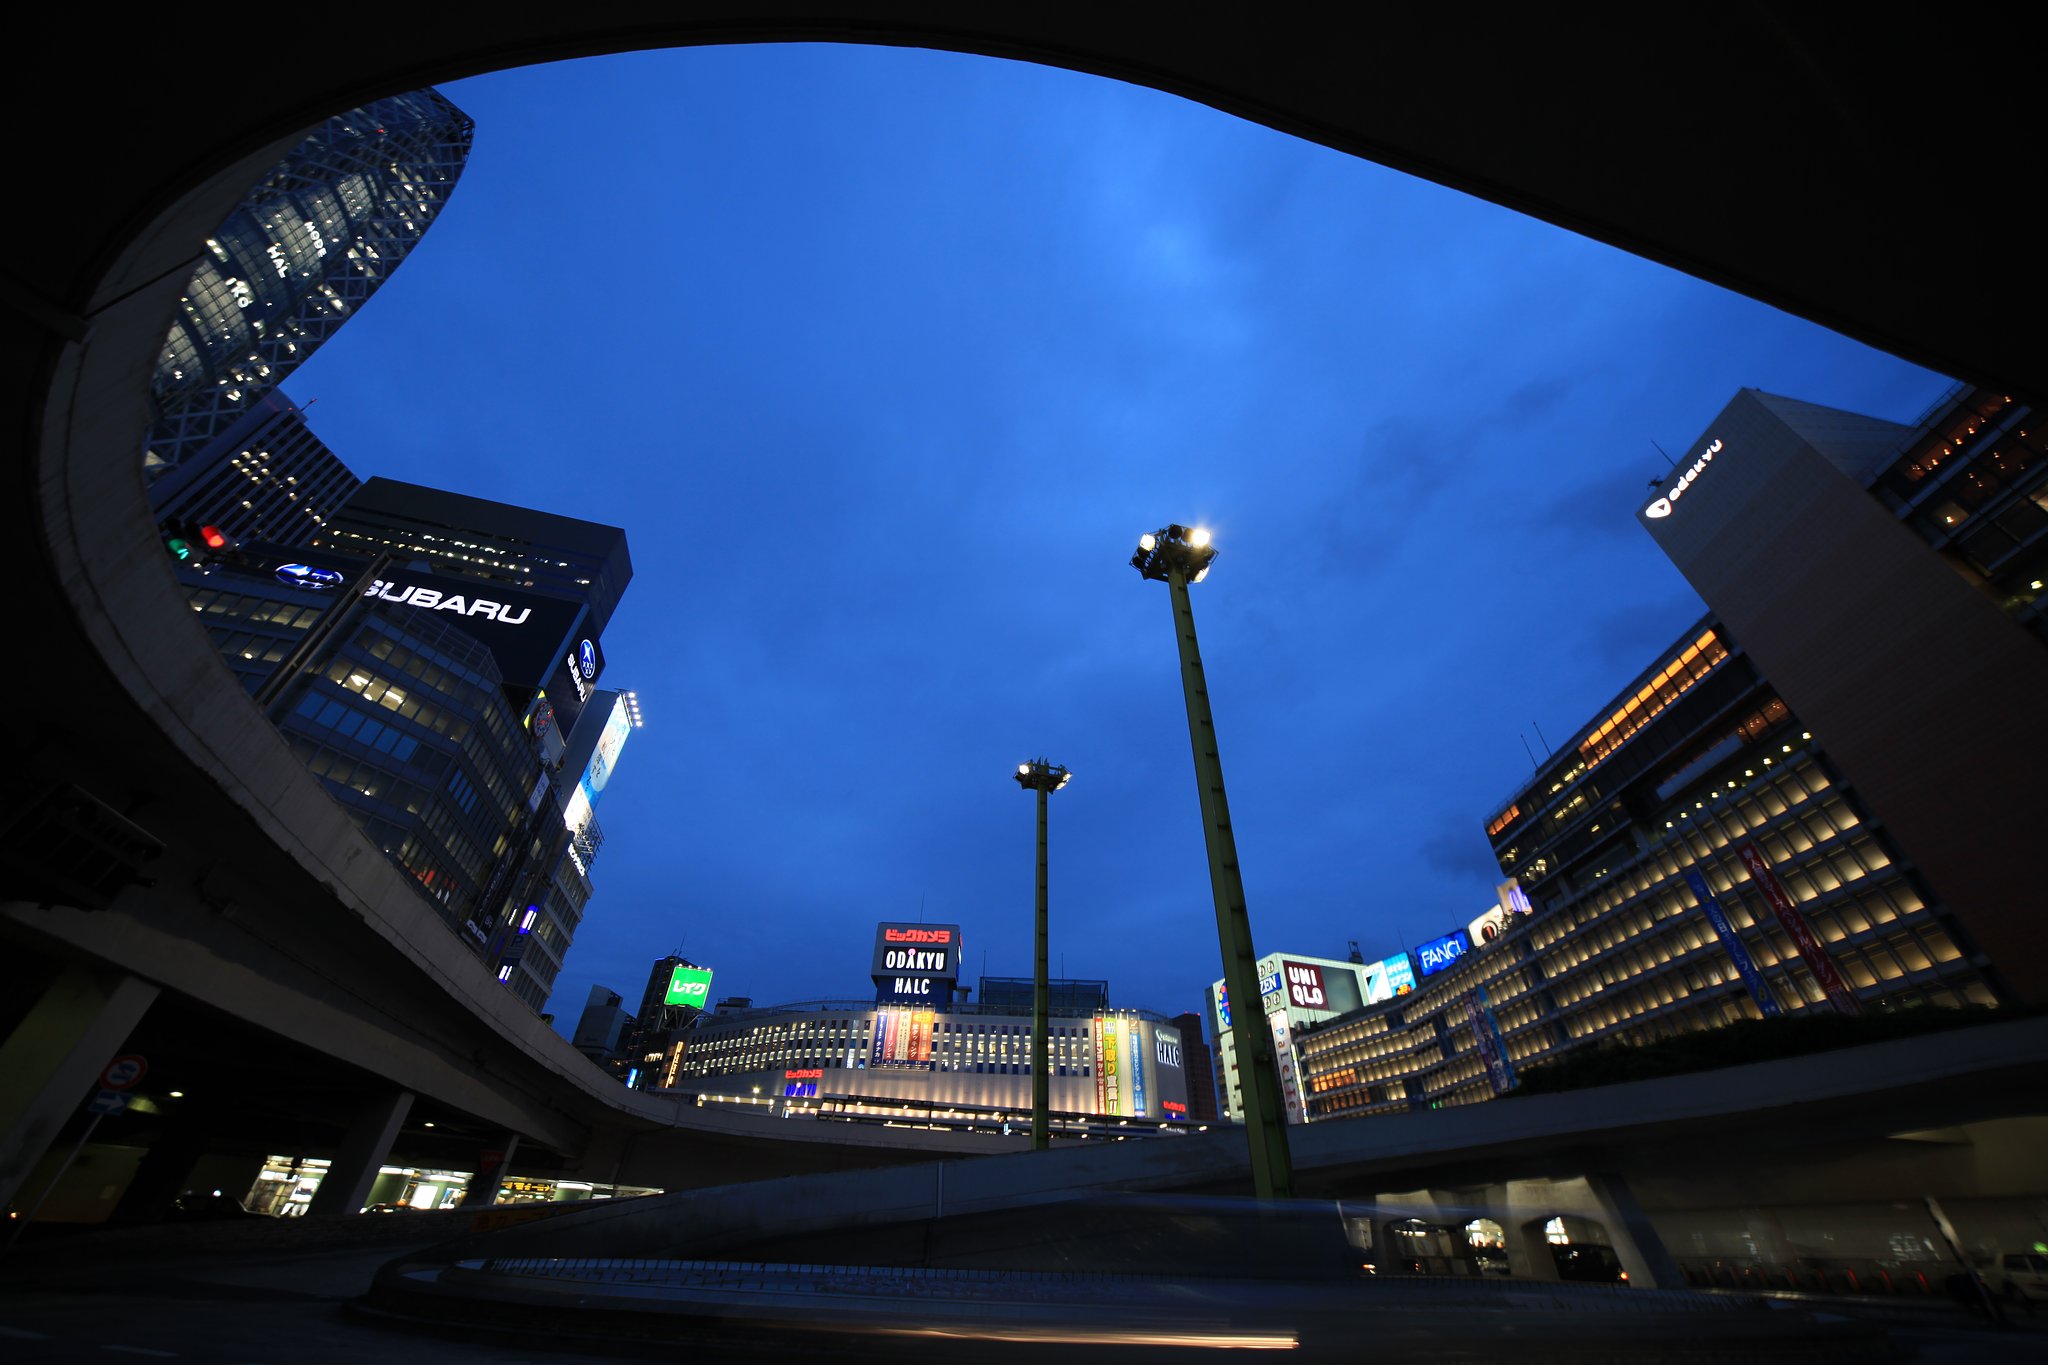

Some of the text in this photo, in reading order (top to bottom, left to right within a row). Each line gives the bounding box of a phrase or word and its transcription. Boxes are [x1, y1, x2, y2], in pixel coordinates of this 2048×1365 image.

[1669, 439, 1723, 501] odakyu
[364, 580, 531, 624] SUBARU
[568, 653, 587, 703] SUBARU
[885, 928, 951, 943] ビックカメラ
[886, 948, 945, 970] ODAKYU
[894, 978, 931, 994] HALC
[1288, 966, 1317, 986] UNI
[673, 980, 706, 995] レイク
[1292, 984, 1324, 1005] QLO
[1157, 1042, 1180, 1067] HALC
